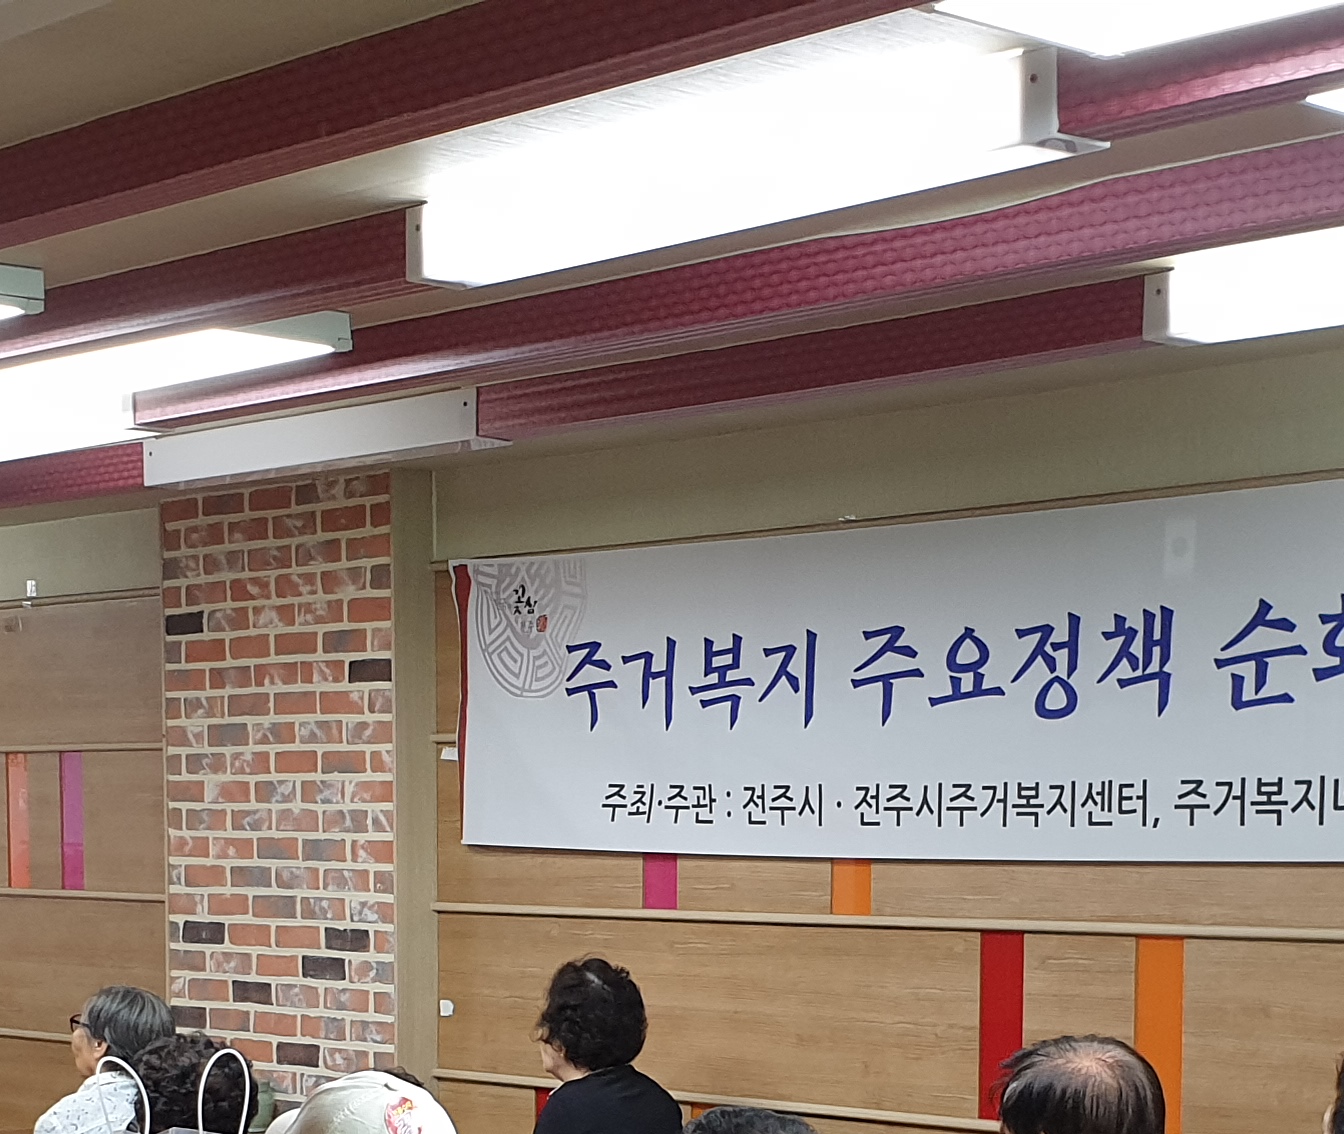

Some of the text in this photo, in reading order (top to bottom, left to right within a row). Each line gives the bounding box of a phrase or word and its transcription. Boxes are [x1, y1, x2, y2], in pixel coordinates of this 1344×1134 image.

[512, 583, 538, 615] 꽃심
[565, 628, 818, 731] 주거복지
[851, 604, 1176, 728] 주요정책
[742, 783, 823, 828] 전주시
[853, 779, 1161, 830] 전주시주거복지센터,
